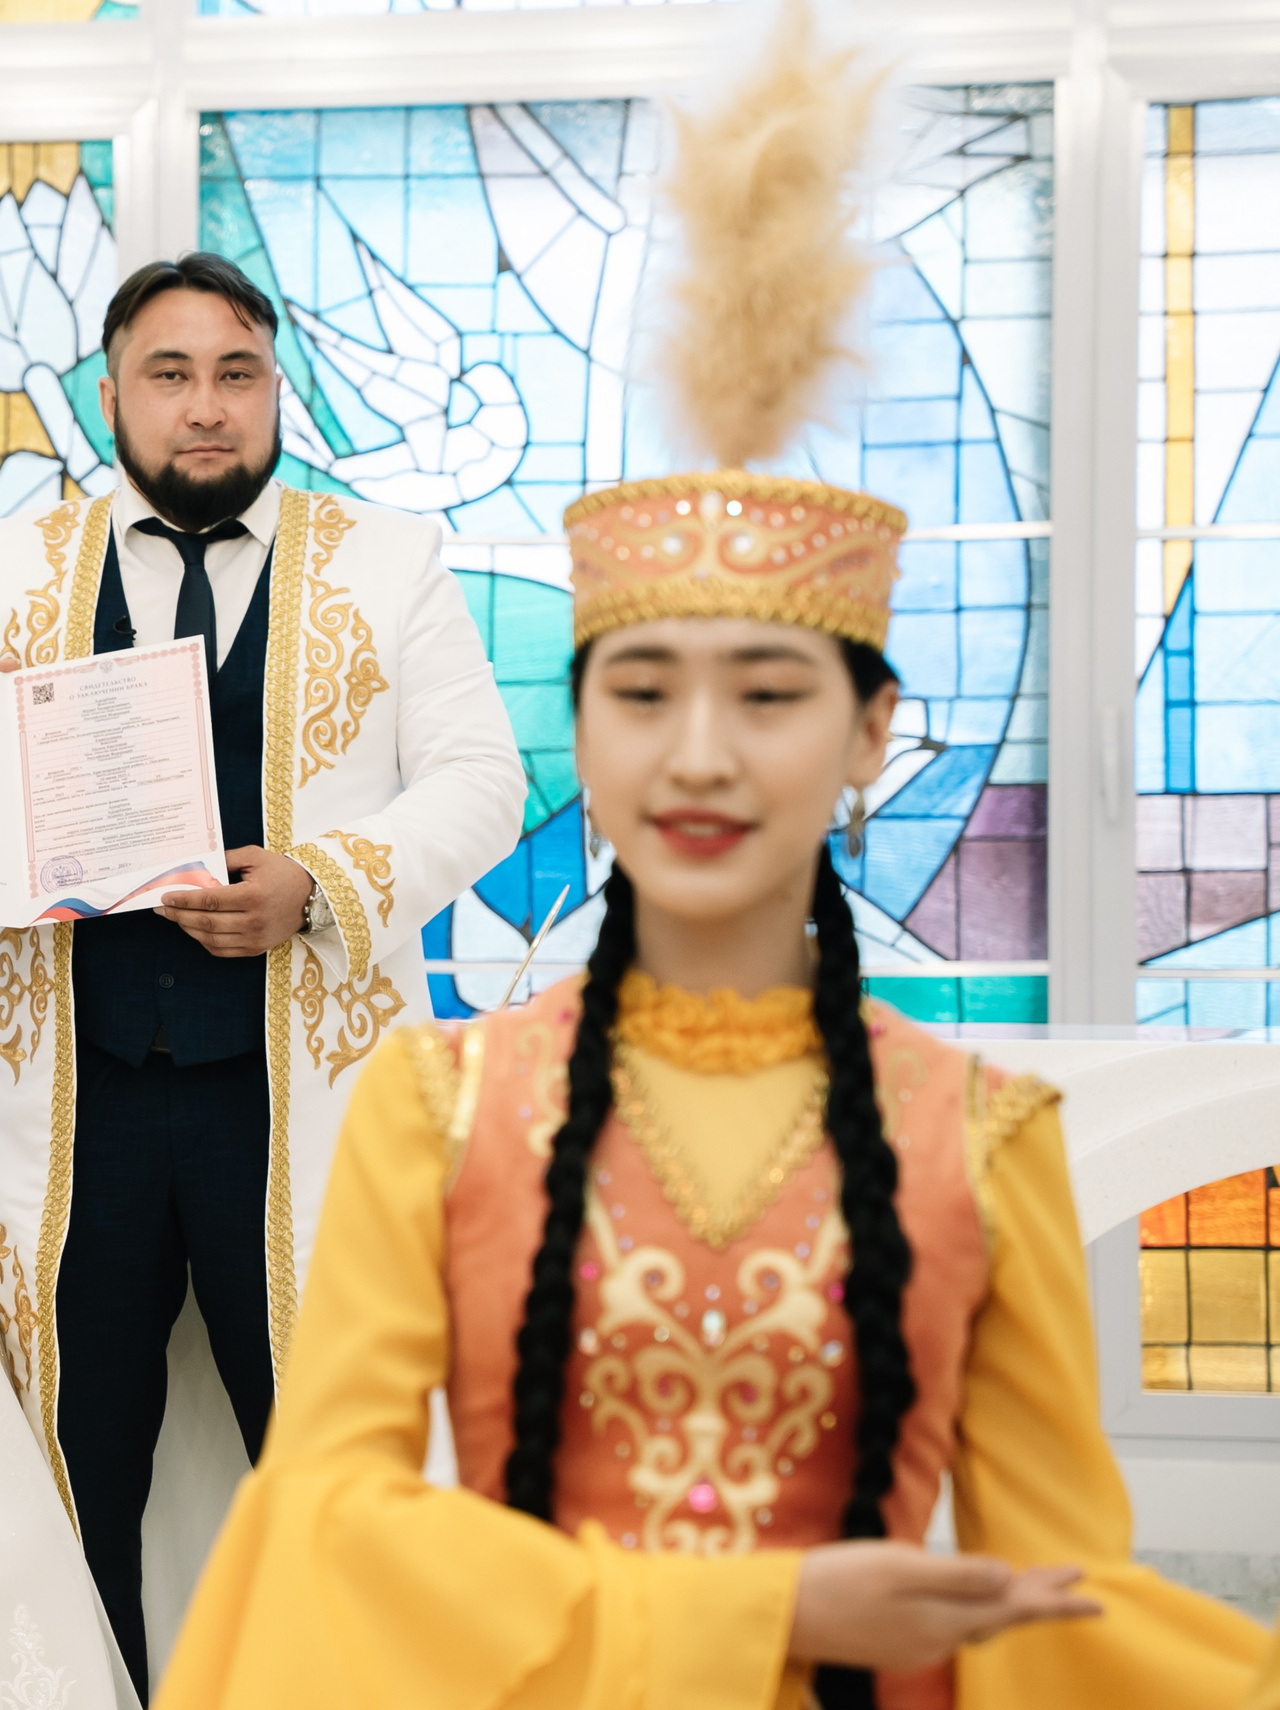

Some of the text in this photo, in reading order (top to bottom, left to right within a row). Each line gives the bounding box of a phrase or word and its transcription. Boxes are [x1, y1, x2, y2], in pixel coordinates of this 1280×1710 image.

[77, 685, 124, 699] ЗАКЛЮЧЕНИИ
[126, 681, 148, 690] БРАКА
[80, 676, 136, 692] СВИДЕТЕЛЬСТВО
